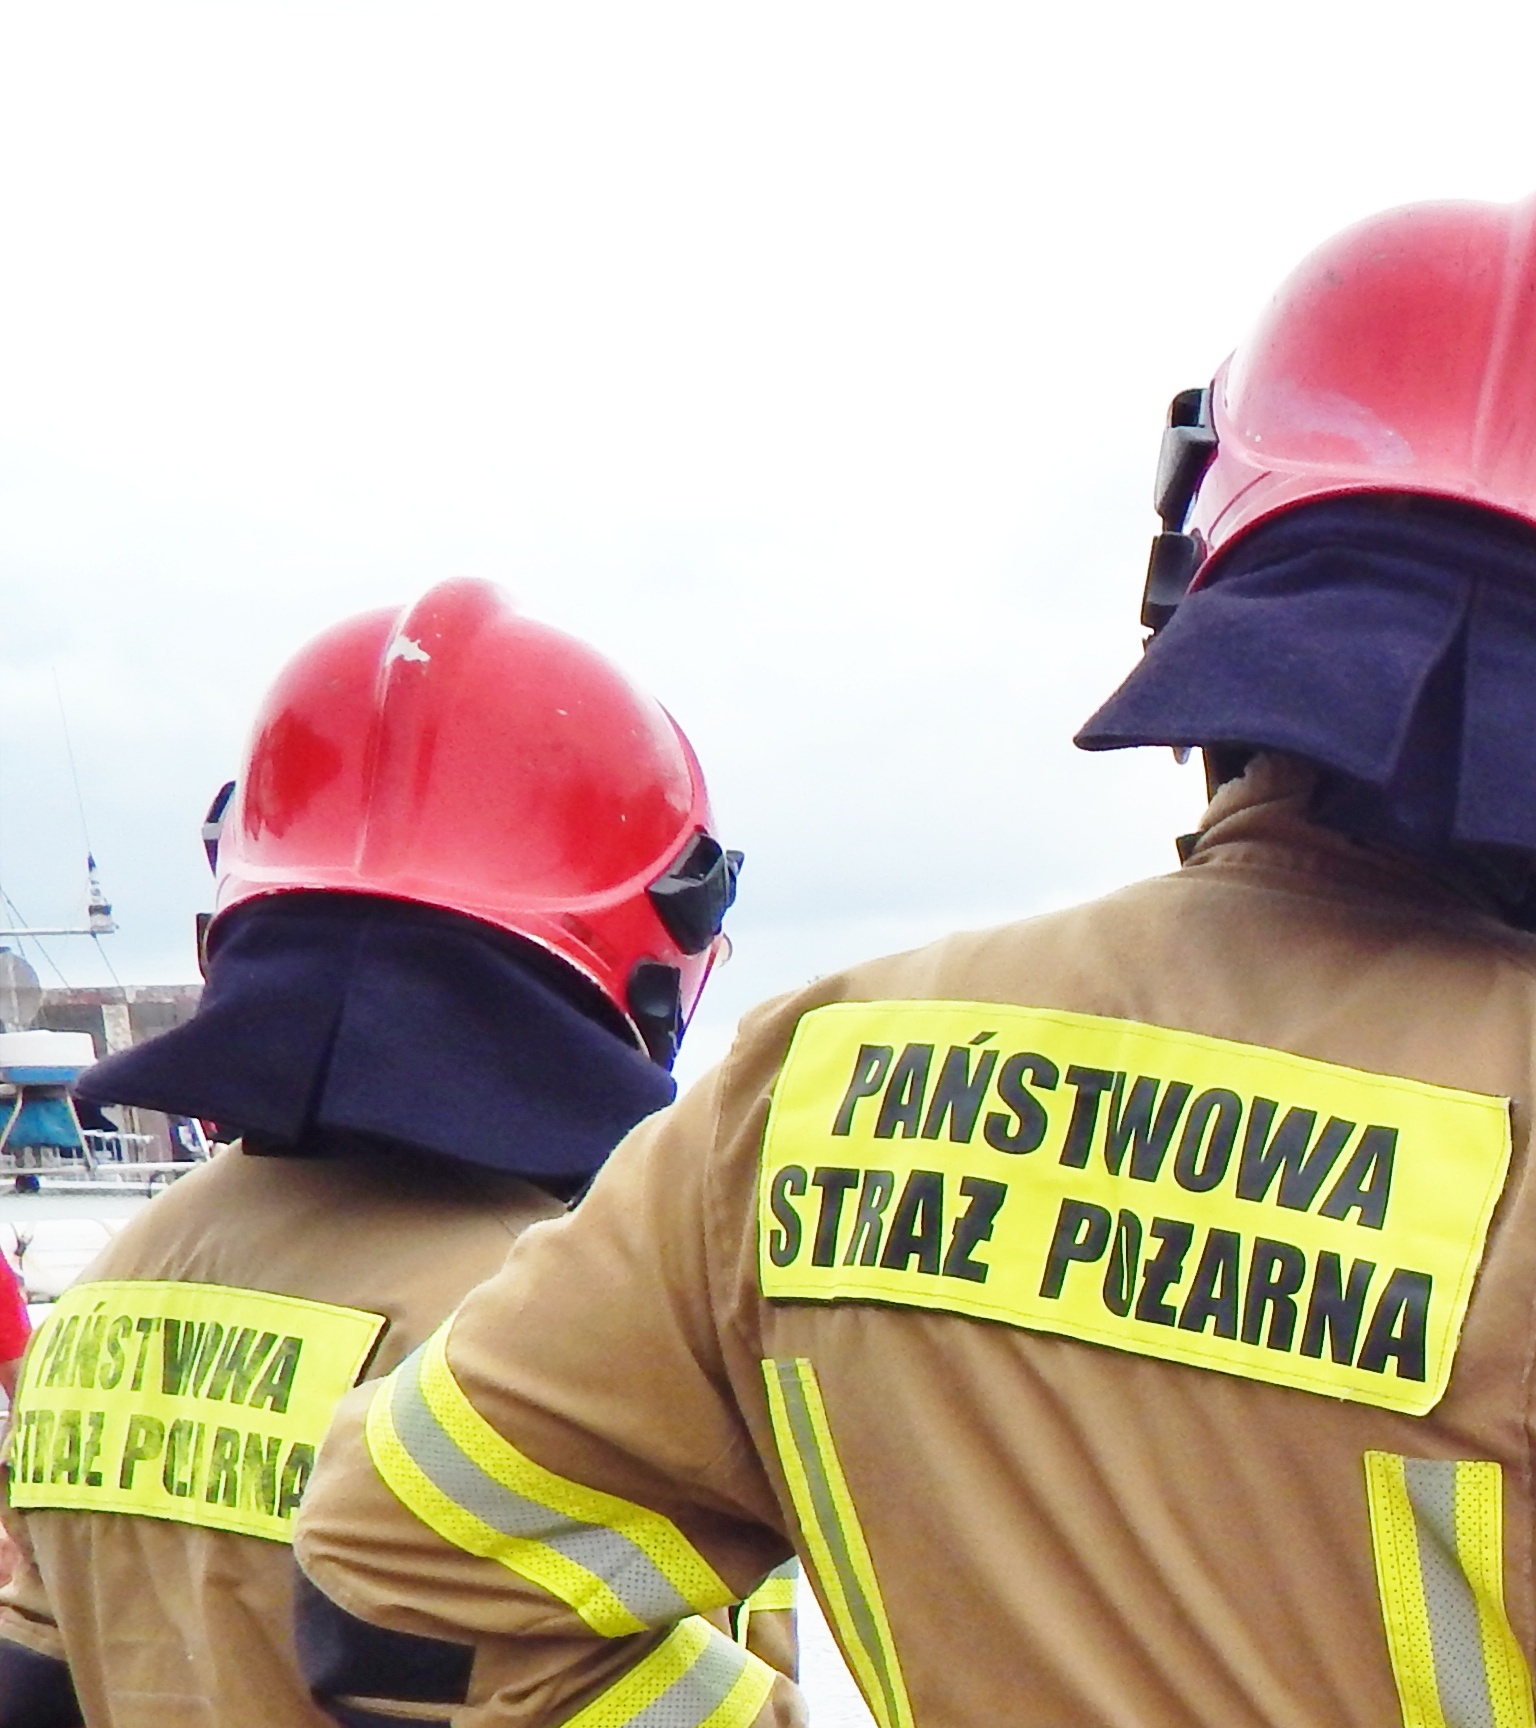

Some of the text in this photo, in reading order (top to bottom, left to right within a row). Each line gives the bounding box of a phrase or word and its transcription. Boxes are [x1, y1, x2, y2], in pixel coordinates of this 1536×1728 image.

[830, 1030, 1400, 1231] PAŃSTWOWA
[769, 1163, 1434, 1384] STRAŻ POŻARNA
[12, 1411, 105, 1487] TRAŻ
